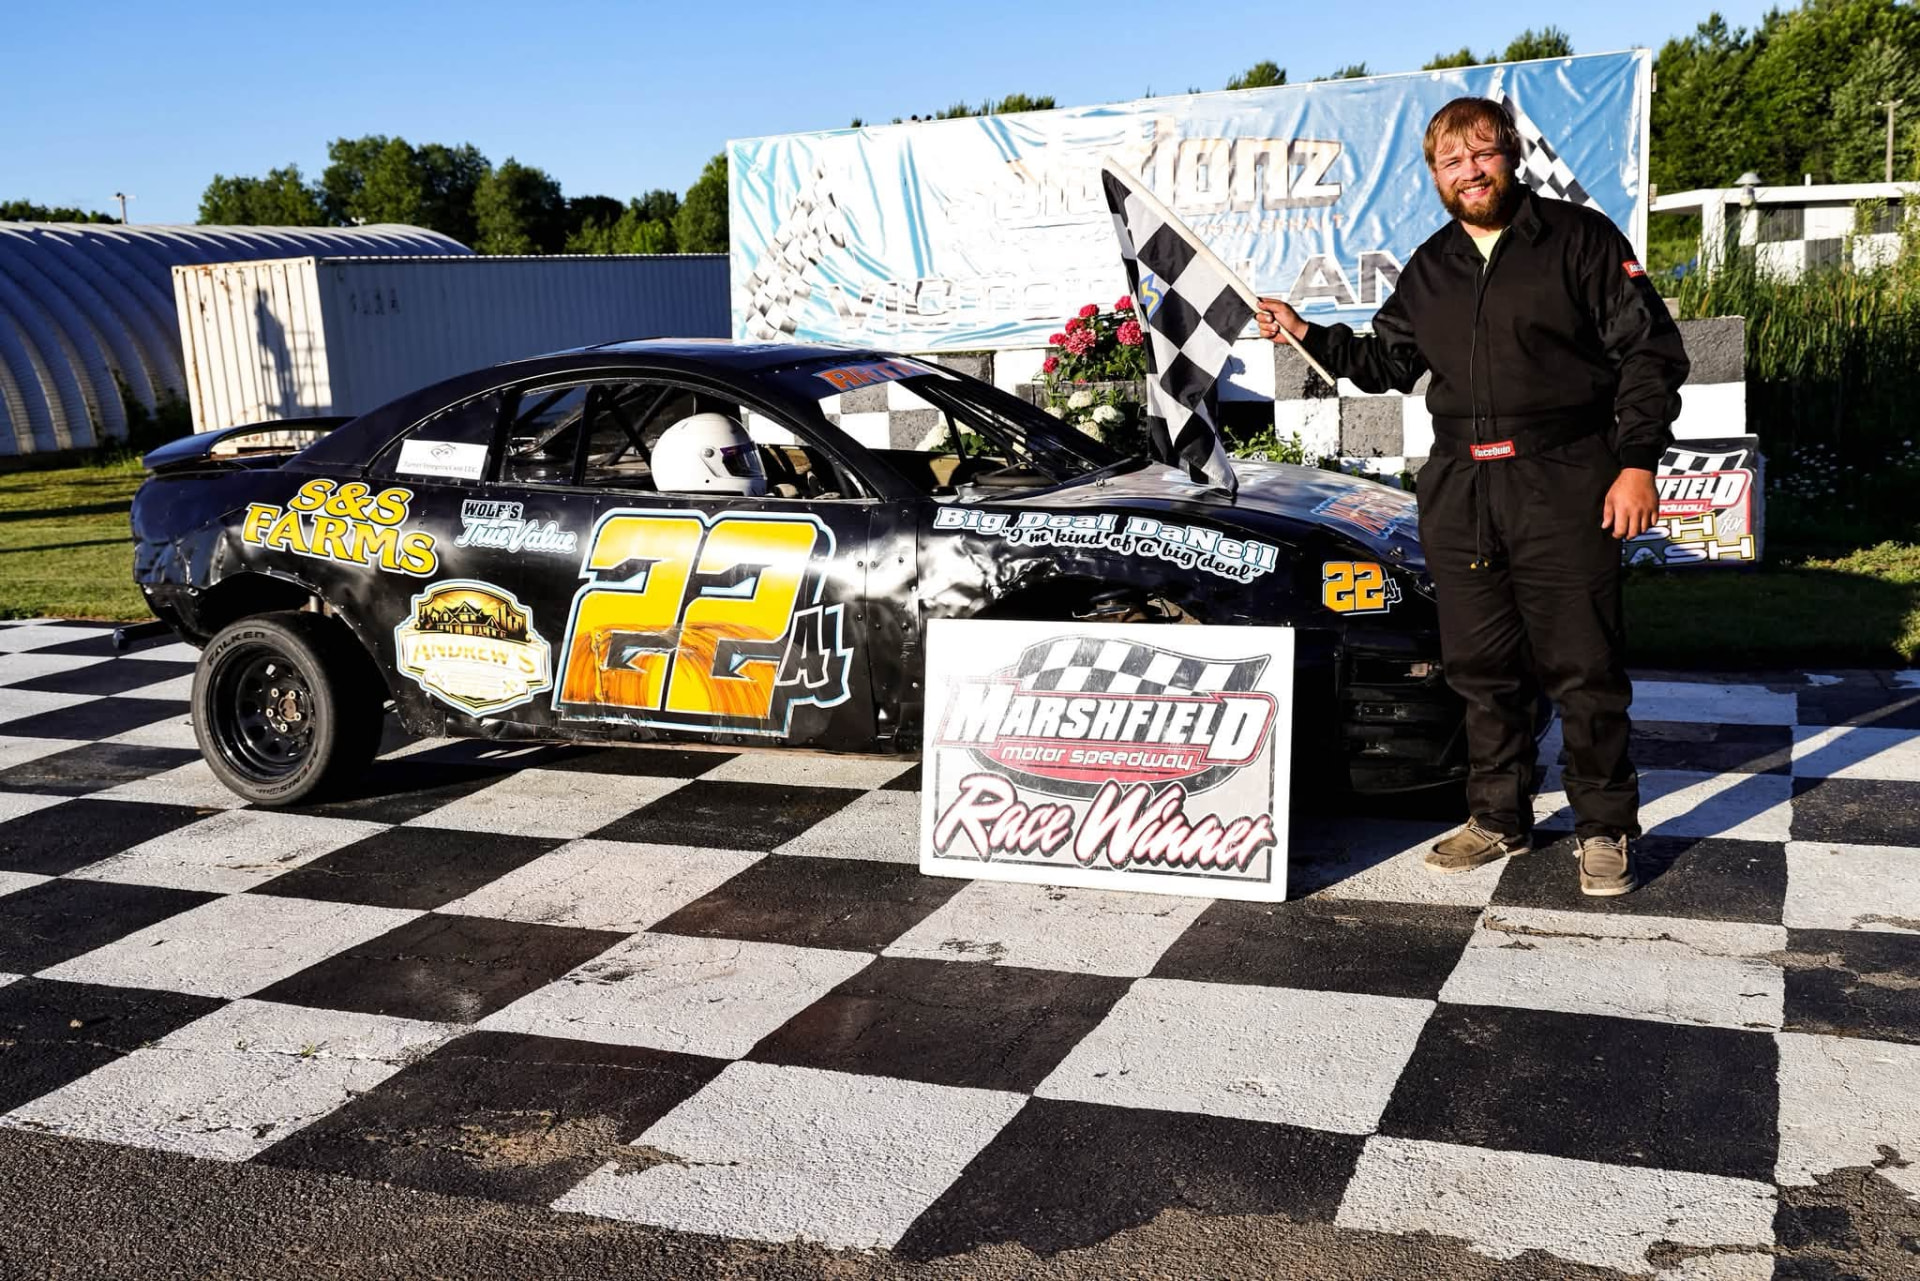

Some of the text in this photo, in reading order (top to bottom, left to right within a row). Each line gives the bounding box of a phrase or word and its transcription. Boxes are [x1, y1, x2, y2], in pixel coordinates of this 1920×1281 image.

[1233, 248, 1425, 312] LAN
[288, 479, 413, 526] S&S
[463, 502, 520, 519] WOLF'S
[1719, 513, 1744, 536] for
[243, 502, 437, 577] FARMS
[934, 508, 1279, 572] Big Deal DaNeil
[1054, 529, 1105, 545] kind
[1110, 534, 1134, 552] of
[1140, 542, 1156, 553] a
[1161, 542, 1195, 566] big
[1628, 536, 1753, 566] ASH
[1323, 561, 1384, 612] 22
[558, 511, 822, 722] 22
[207, 631, 266, 667] FALKEN
[940, 679, 1275, 762] MARSHFIELD
[1001, 745, 1194, 771] motor speedway
[933, 772, 1278, 873] Race Winner
